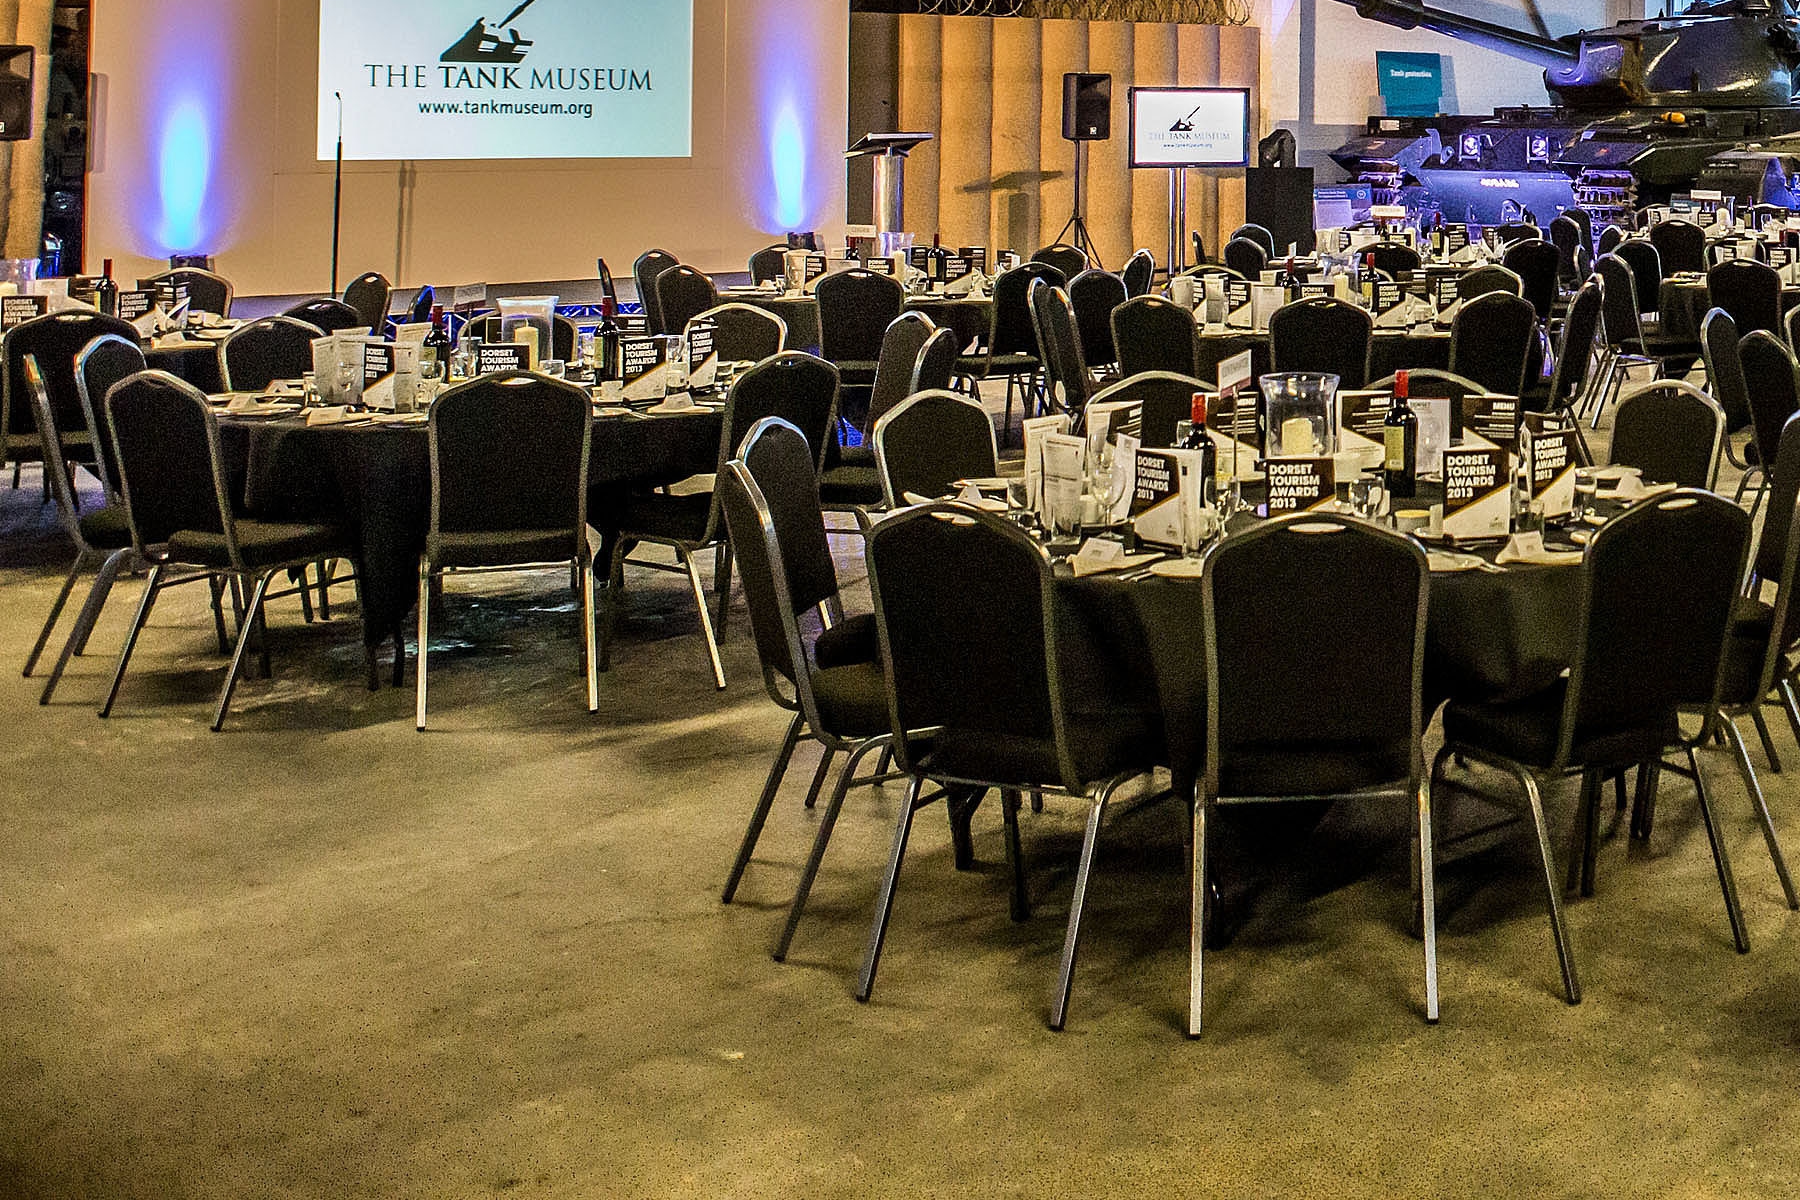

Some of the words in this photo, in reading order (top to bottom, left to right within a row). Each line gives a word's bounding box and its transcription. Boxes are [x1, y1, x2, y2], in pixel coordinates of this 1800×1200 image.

[364, 64, 426, 88] THE
[437, 66, 523, 89] TANK
[530, 68, 653, 90] MUSEUM
[418, 99, 593, 118] www.tankmuseum.org
[1169, 132, 1192, 140] TANK
[625, 341, 654, 350] DORSET
[481, 349, 514, 357] DORSET
[625, 349, 658, 358] TOURISM
[481, 356, 519, 365] TOURISM
[625, 357, 657, 366] AWARDS
[625, 365, 643, 374] 2013
[1492, 402, 1515, 411] MENU
[1535, 437, 1564, 450] DORSET
[1535, 446, 1567, 460] TOURISM
[1137, 455, 1165, 469] DORSET
[1447, 454, 1490, 466] DORSET
[1535, 456, 1566, 471] AWARDS
[1137, 466, 1170, 481] TOURISM
[1269, 464, 1313, 475] DORSET
[1447, 465, 1496, 476] TOURISM
[1137, 478, 1169, 492] AWARDS
[1269, 475, 1320, 486] TOURISM
[1447, 476, 1495, 488] AWARDS
[1137, 488, 1154, 500] 2013
[1270, 487, 1319, 498] AWARDS
[1447, 487, 1473, 499] 2013
[1270, 498, 1297, 509] 2013
